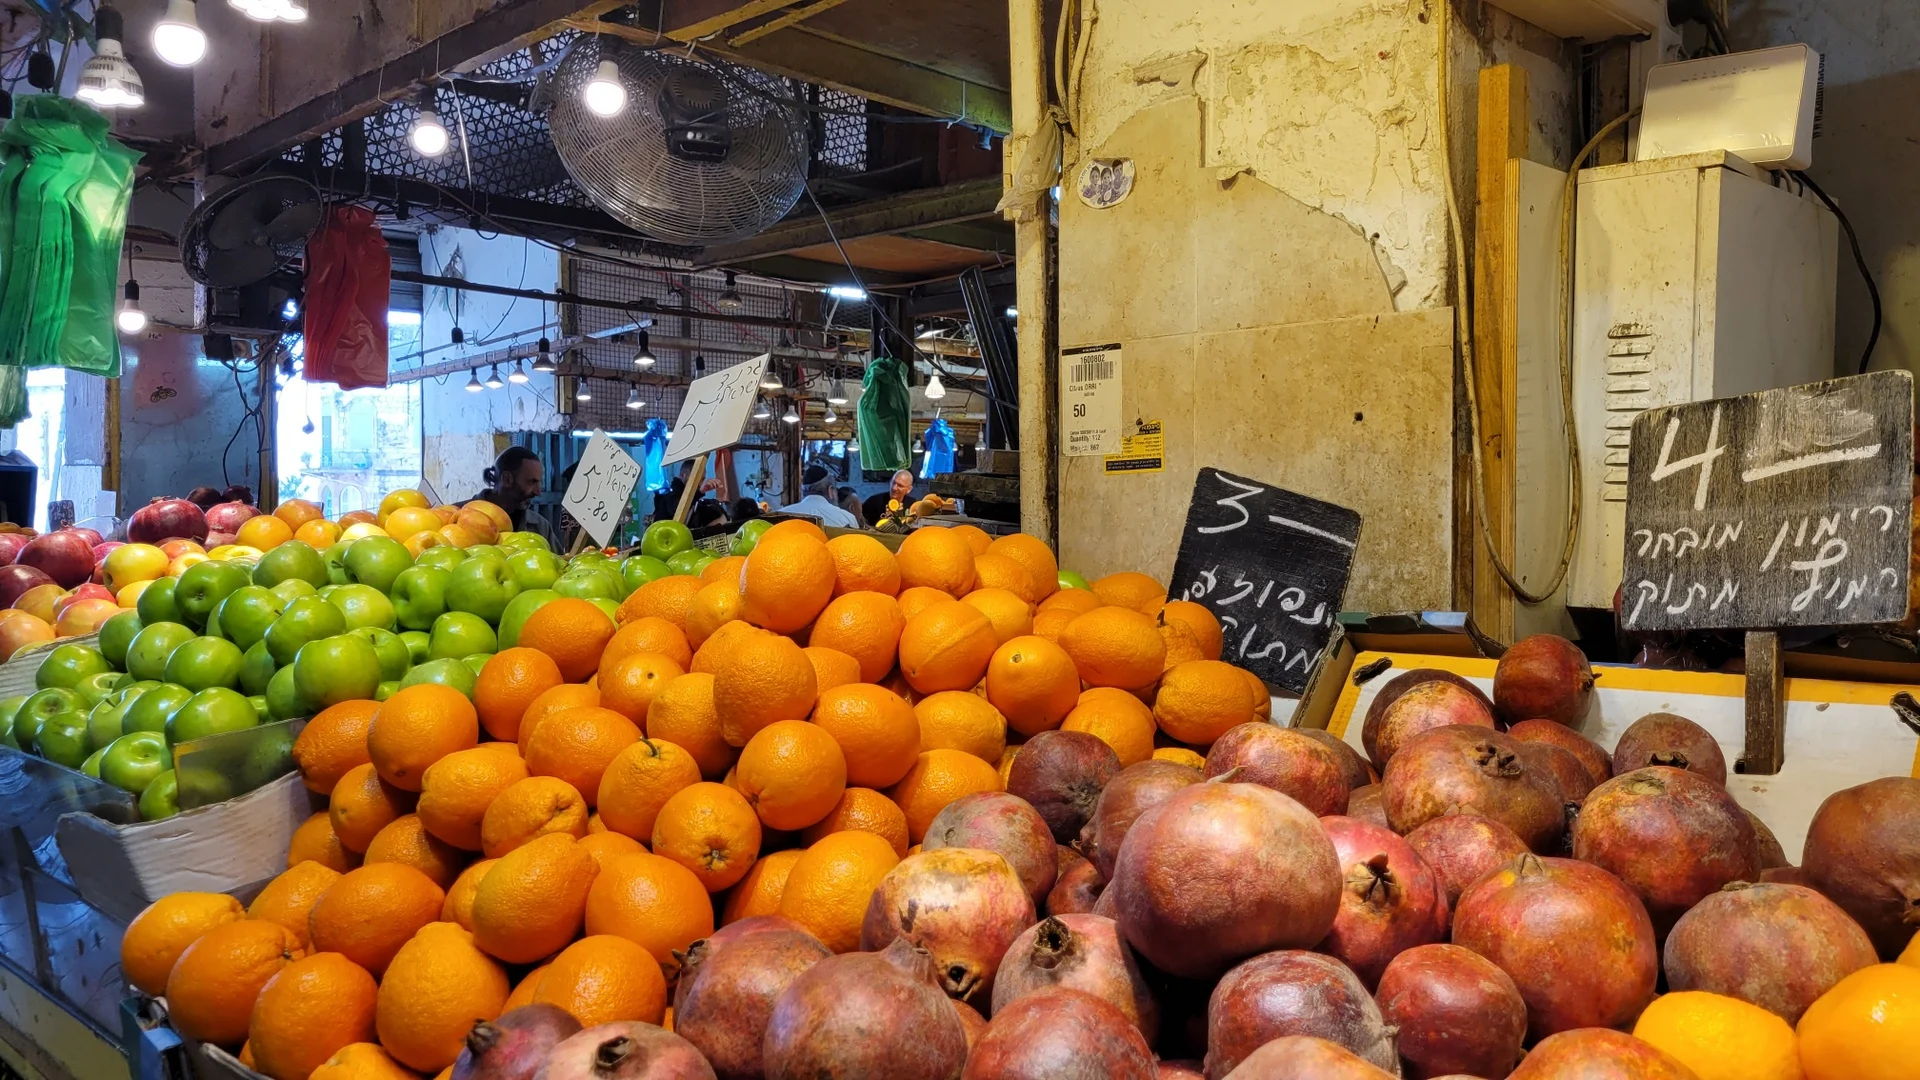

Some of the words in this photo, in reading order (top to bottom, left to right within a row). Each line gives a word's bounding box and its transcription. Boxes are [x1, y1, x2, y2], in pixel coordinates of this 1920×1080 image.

[666, 398, 717, 457] 5
[1073, 403, 1086, 417] 50
[1651, 403, 1728, 511] 4
[1197, 472, 1265, 534] 3
[1634, 521, 1744, 559] מובחר
[1759, 505, 1893, 572] רימון
[1629, 573, 1741, 626] מתוק
